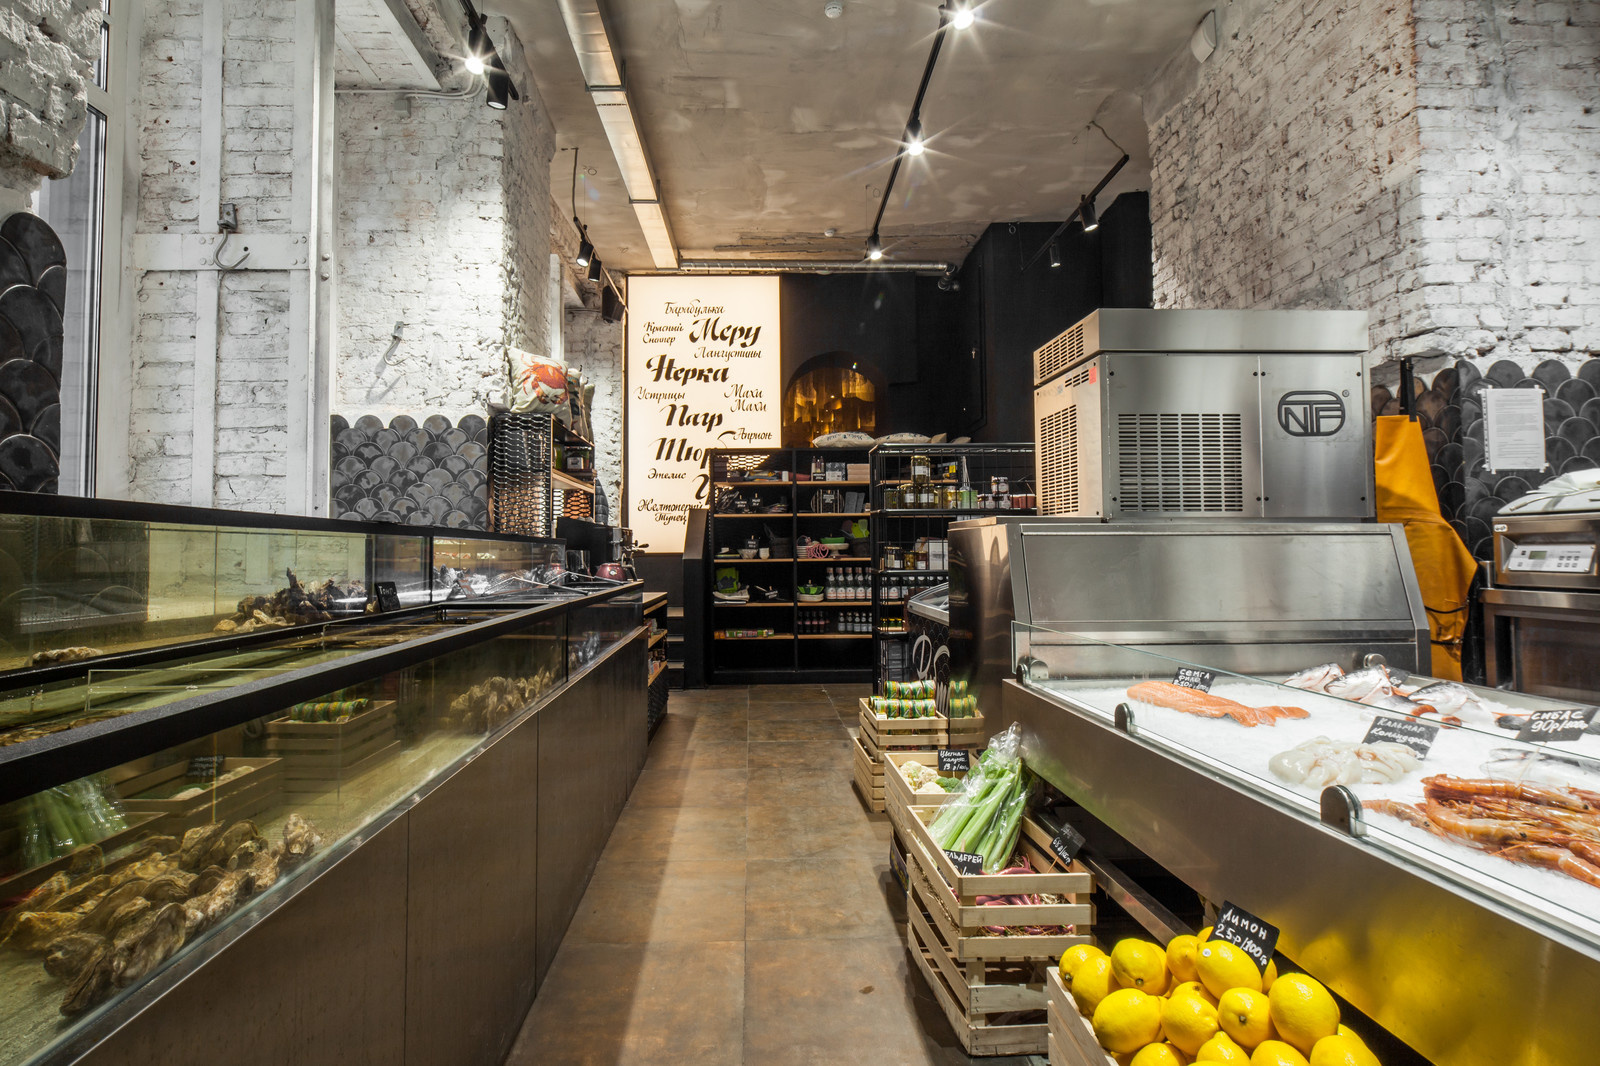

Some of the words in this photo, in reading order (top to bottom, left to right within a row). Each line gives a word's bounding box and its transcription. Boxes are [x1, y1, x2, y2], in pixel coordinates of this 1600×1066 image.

[664, 299, 725, 317] Барабулька
[644, 321, 684, 333] Красный
[689, 316, 762, 348] Меру
[694, 347, 762, 362] Лангустины
[646, 354, 730, 386] Нерка
[634, 386, 686, 403] Устрицы
[723, 384, 764, 399] Махи
[730, 399, 767, 413] Махи
[1280, 392, 1344, 436] NTF
[654, 512, 687, 526] Тунец
[1222, 907, 1267, 940] ЛИМОН
